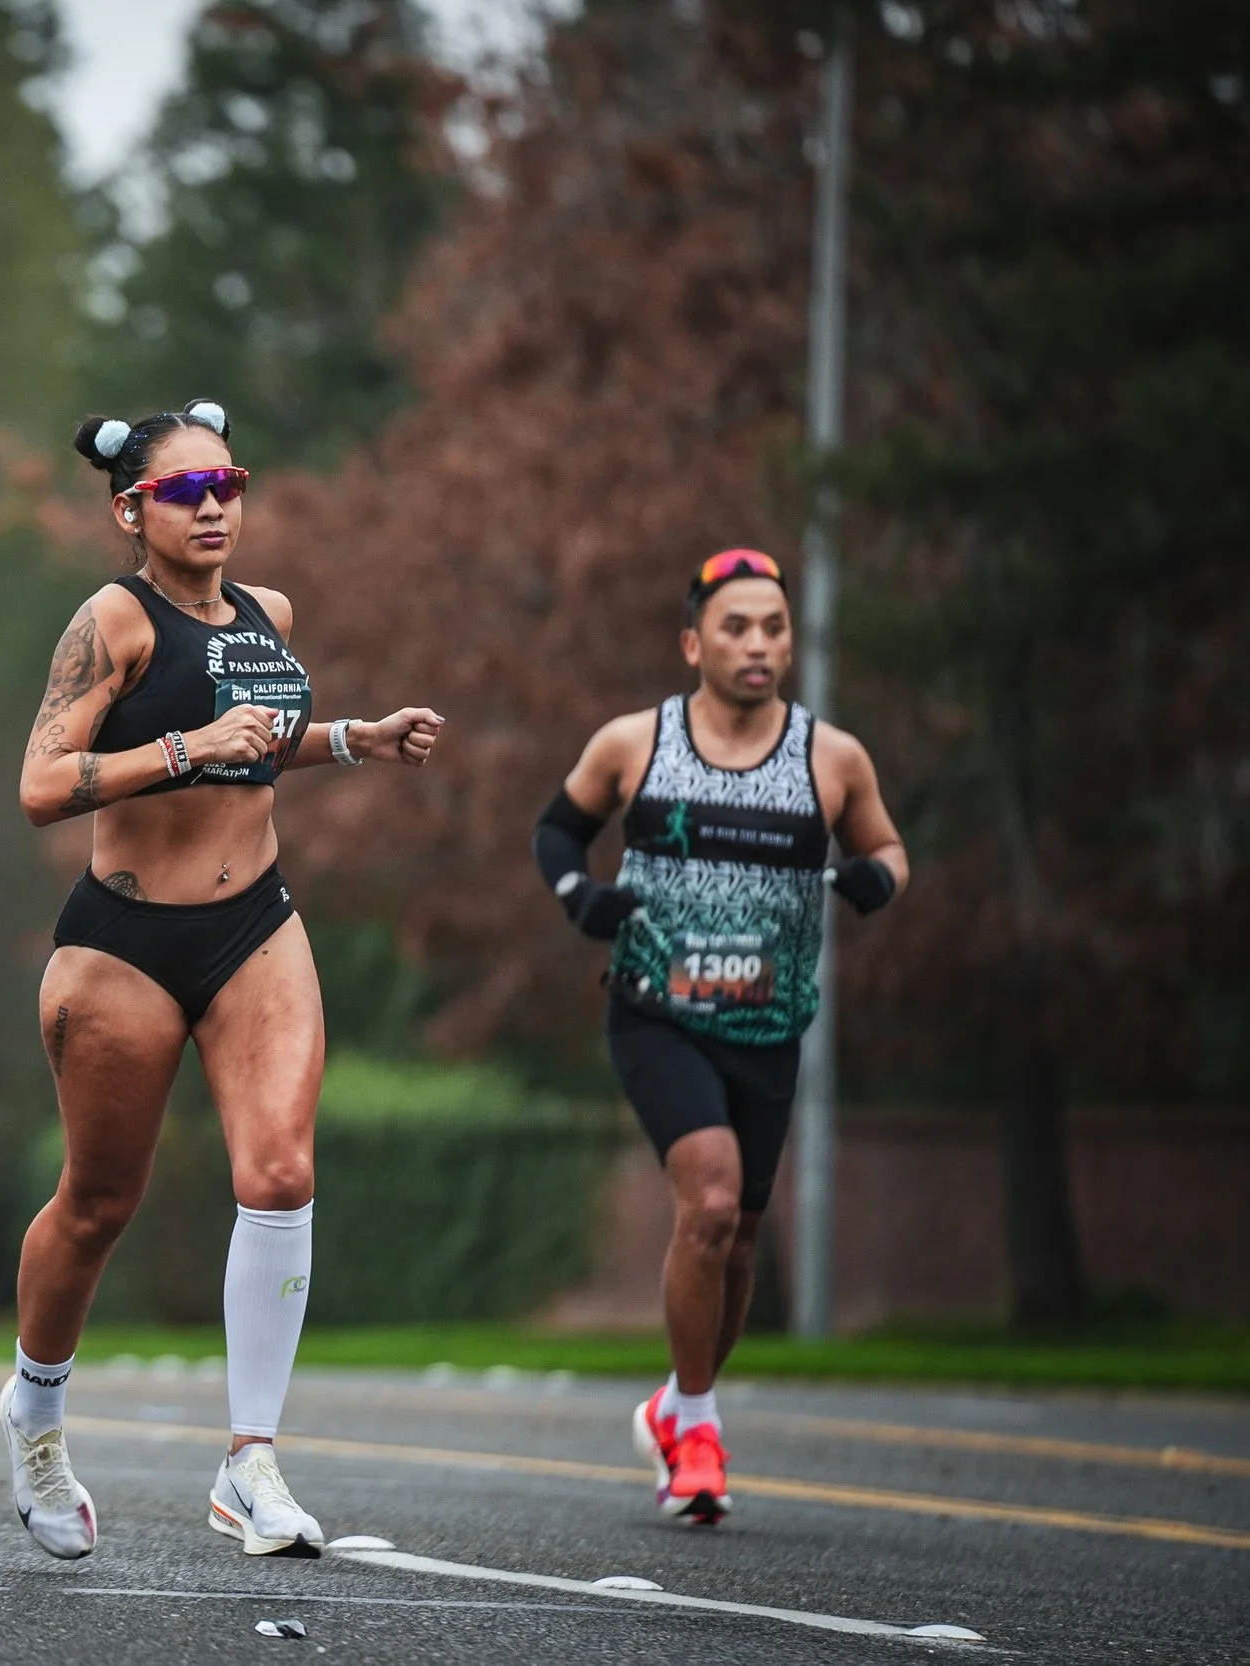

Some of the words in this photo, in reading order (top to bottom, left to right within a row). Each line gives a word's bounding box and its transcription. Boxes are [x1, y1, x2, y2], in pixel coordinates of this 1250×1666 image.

[207, 636, 227, 675] RUN
[218, 631, 276, 651] WITH
[228, 661, 294, 673] PASADENA
[253, 683, 302, 694] CALIFORNIA
[232, 690, 251, 701] CIM
[683, 952, 762, 984] 1300
